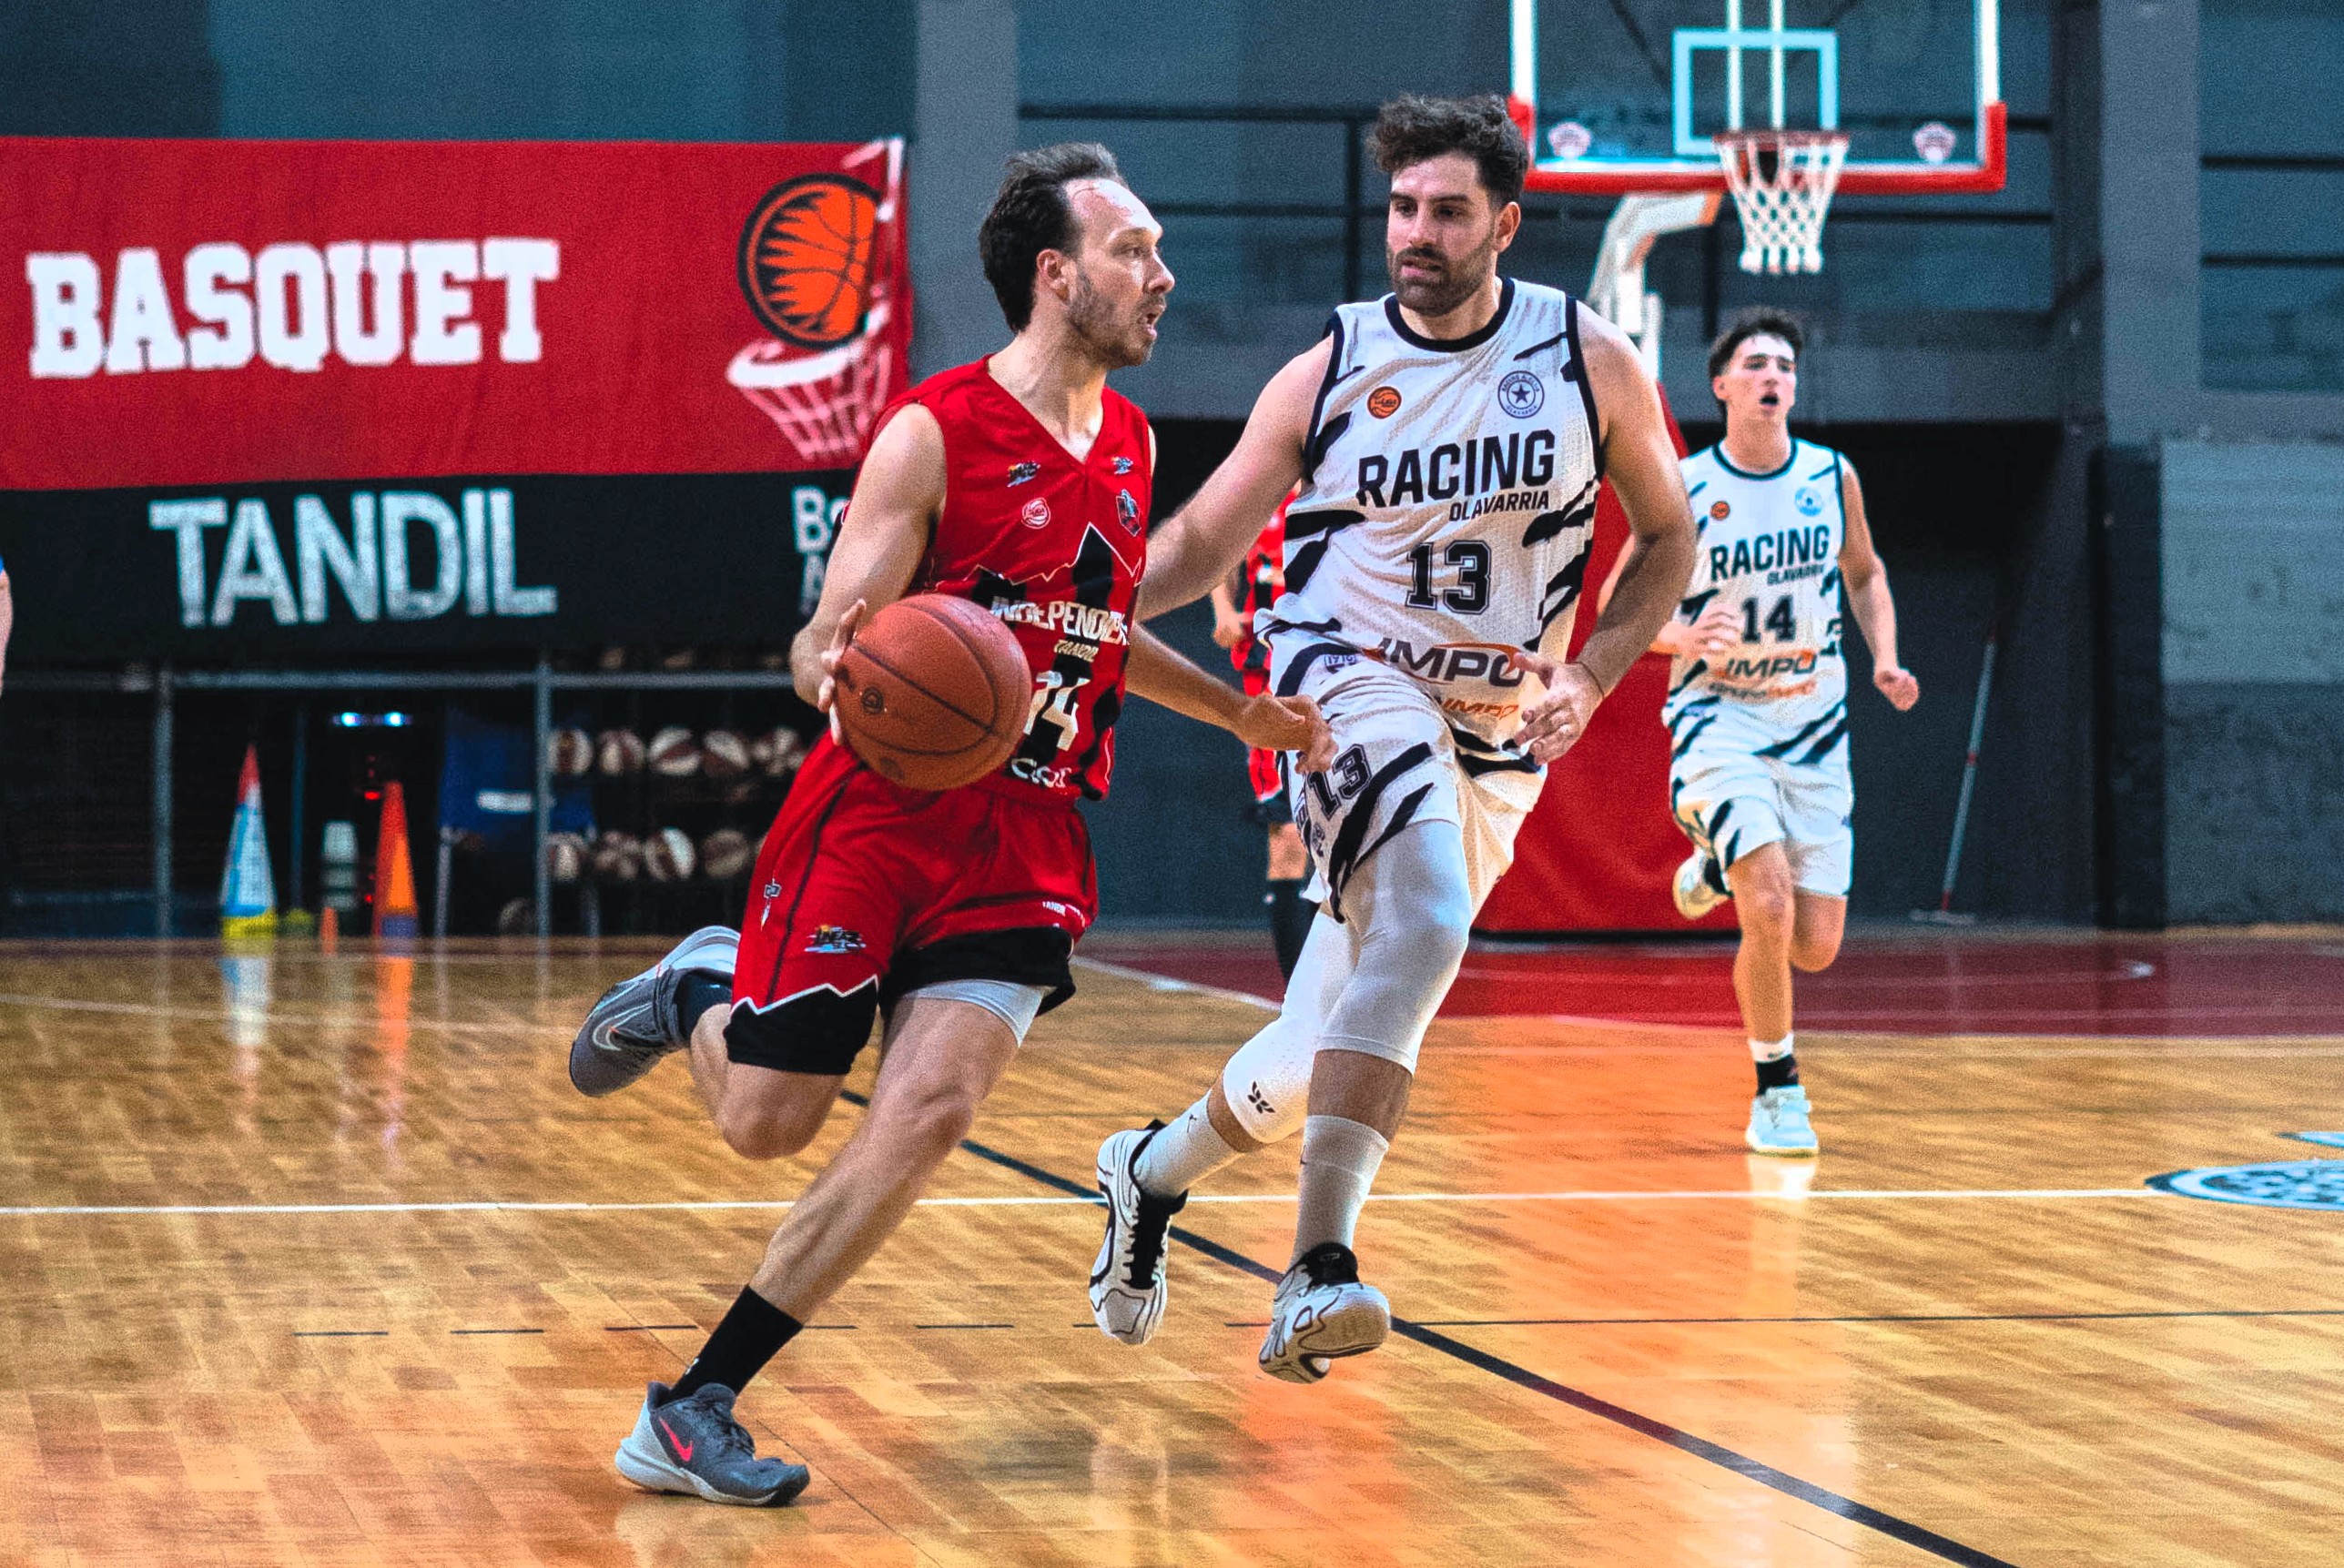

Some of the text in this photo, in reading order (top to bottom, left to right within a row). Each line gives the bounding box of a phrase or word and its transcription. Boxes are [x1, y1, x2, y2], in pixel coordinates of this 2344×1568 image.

[26, 238, 560, 379] BASQUET
[1356, 430, 1556, 508] RACING
[1449, 491, 1549, 522] OLAVARRIA
[148, 489, 557, 626] TANDIL
[1405, 539, 1492, 615] 13
[1710, 525, 1830, 582] RACING
[1740, 594, 1796, 643] 14
[1378, 637, 1526, 687] IMPO
[1307, 744, 1372, 821] 13
